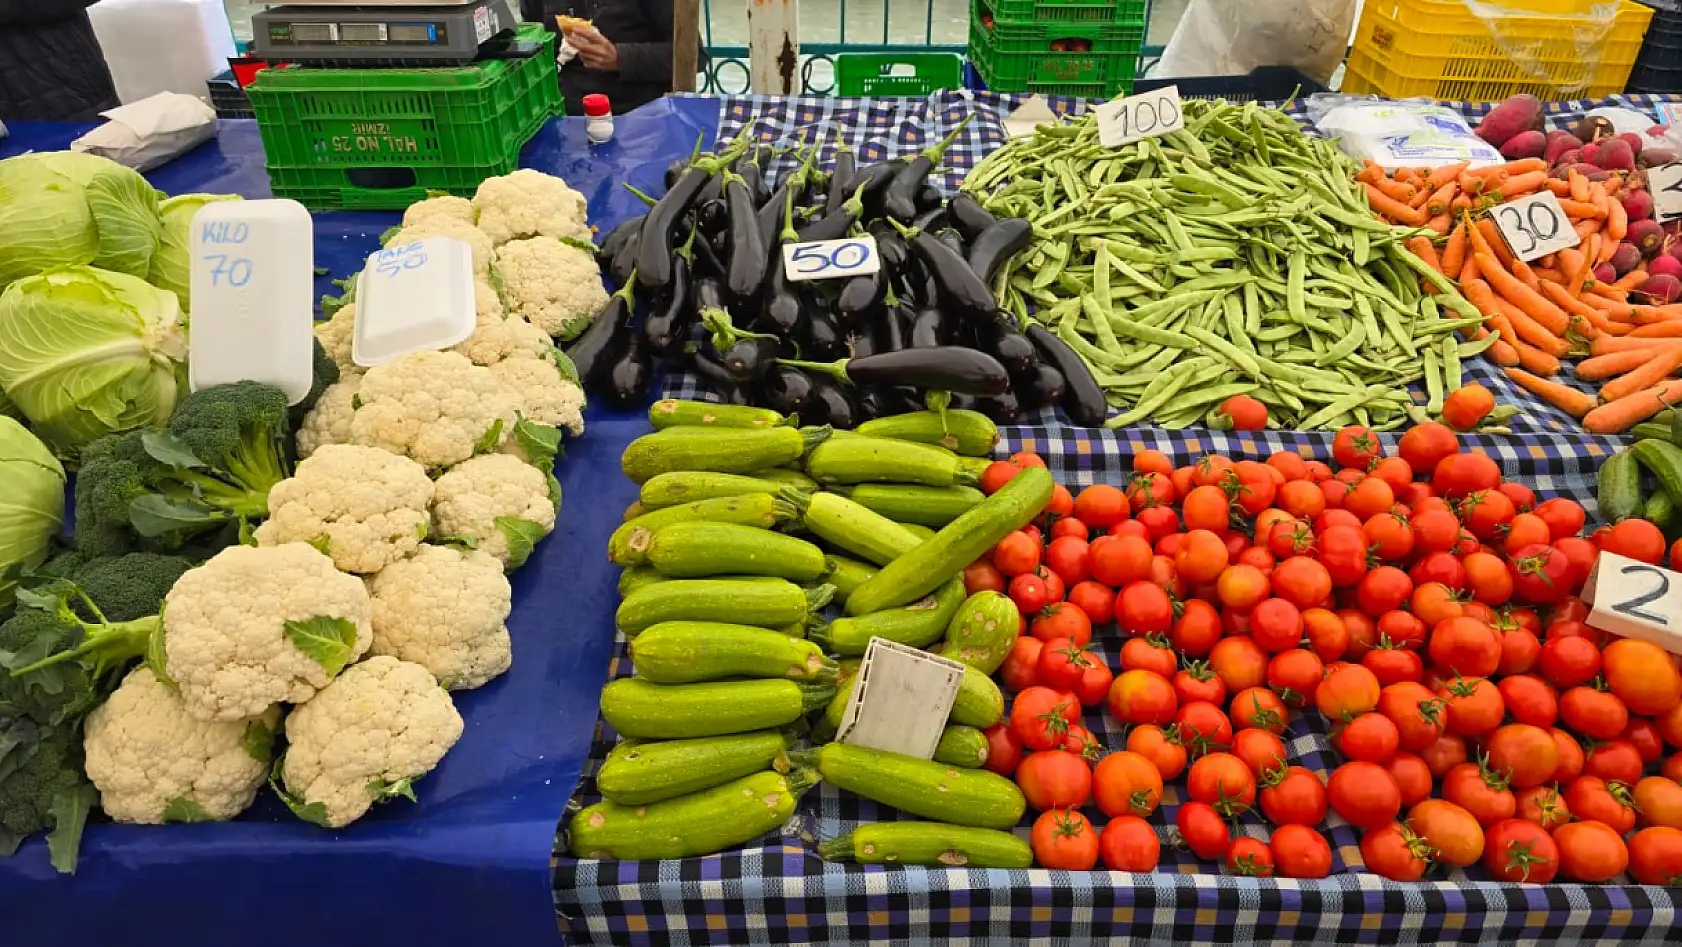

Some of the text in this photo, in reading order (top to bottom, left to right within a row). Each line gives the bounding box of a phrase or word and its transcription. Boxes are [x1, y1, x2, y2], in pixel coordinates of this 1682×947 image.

[1113, 97, 1178, 137] 100
[331, 135, 418, 152] HAL NO 25
[1500, 202, 1559, 254] 30
[203, 253, 253, 287] 70
[375, 252, 428, 278] 50
[791, 242, 870, 272] 50
